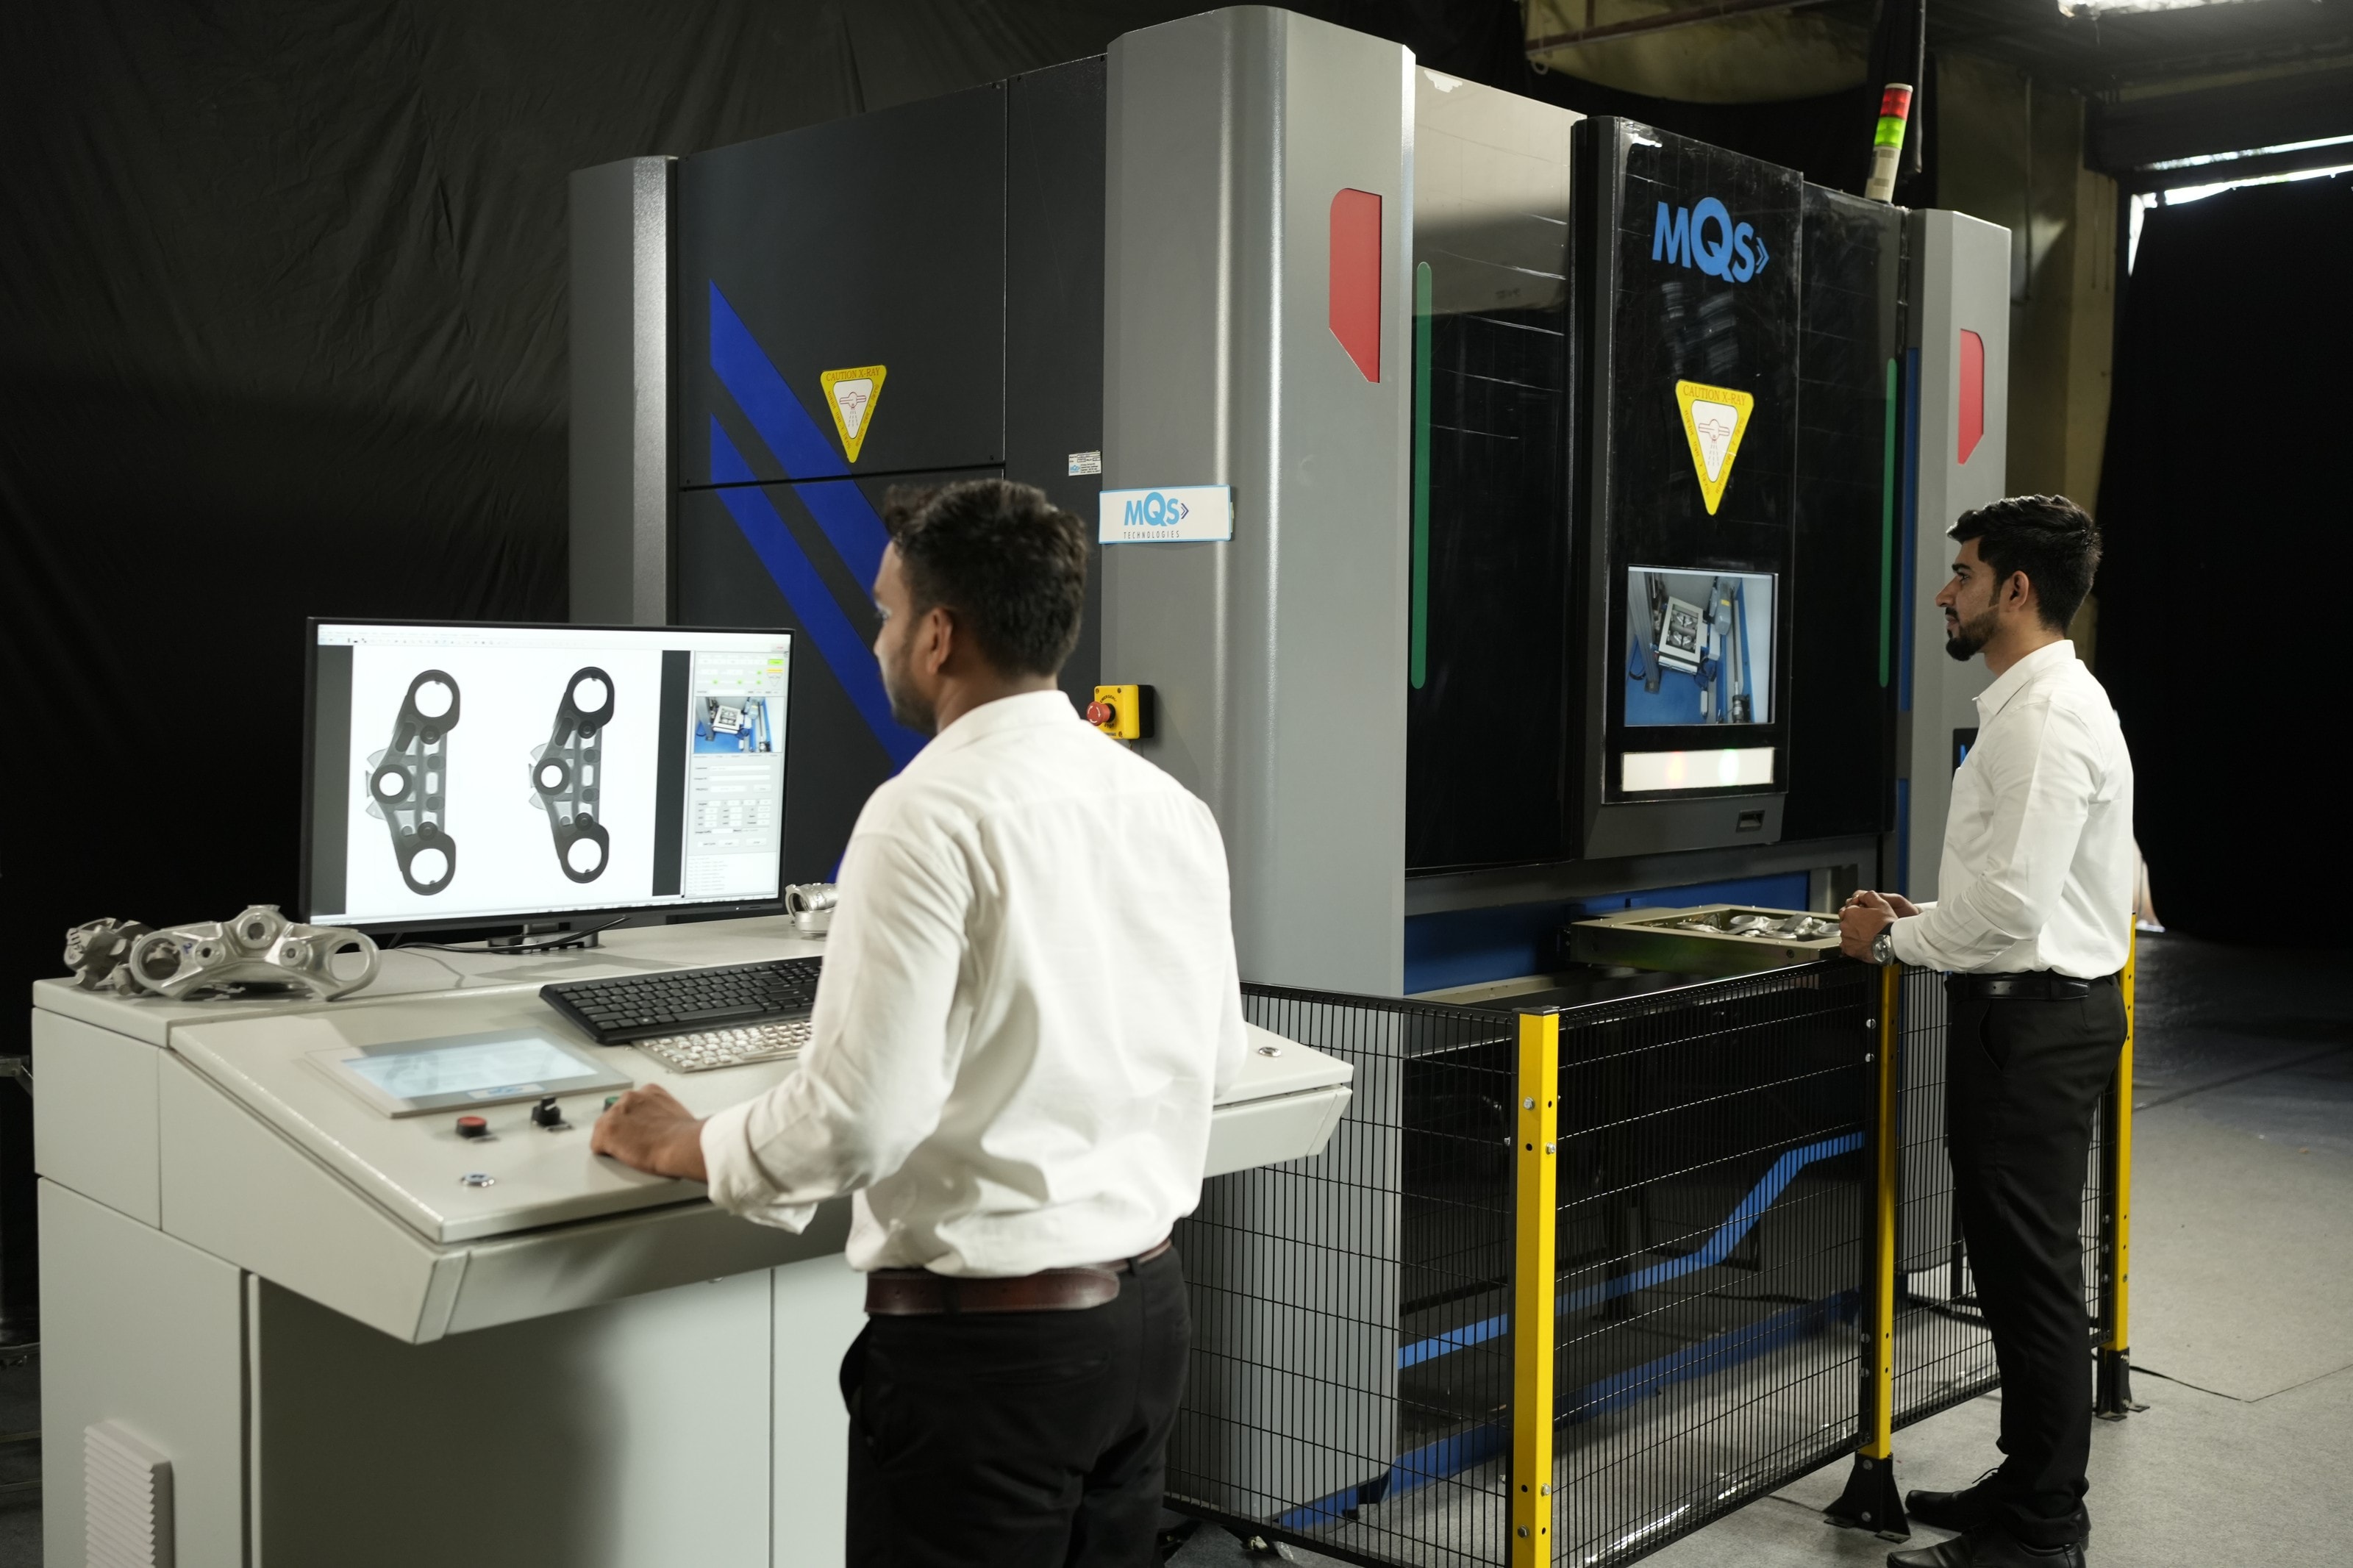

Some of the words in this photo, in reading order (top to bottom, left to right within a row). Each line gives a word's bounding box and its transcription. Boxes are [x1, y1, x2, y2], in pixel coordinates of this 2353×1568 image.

[1652, 197, 1755, 283] MQS
[826, 370, 857, 382] CAUTION
[858, 368, 880, 378] X-RAY
[1683, 385, 1720, 401] CAUTION
[1722, 393, 1746, 406] X-RAY
[1124, 492, 1180, 526] MQS
[1124, 530, 1179, 540] TECHNOLOGIES
[1100, 695, 1117, 704] EMERGEN
